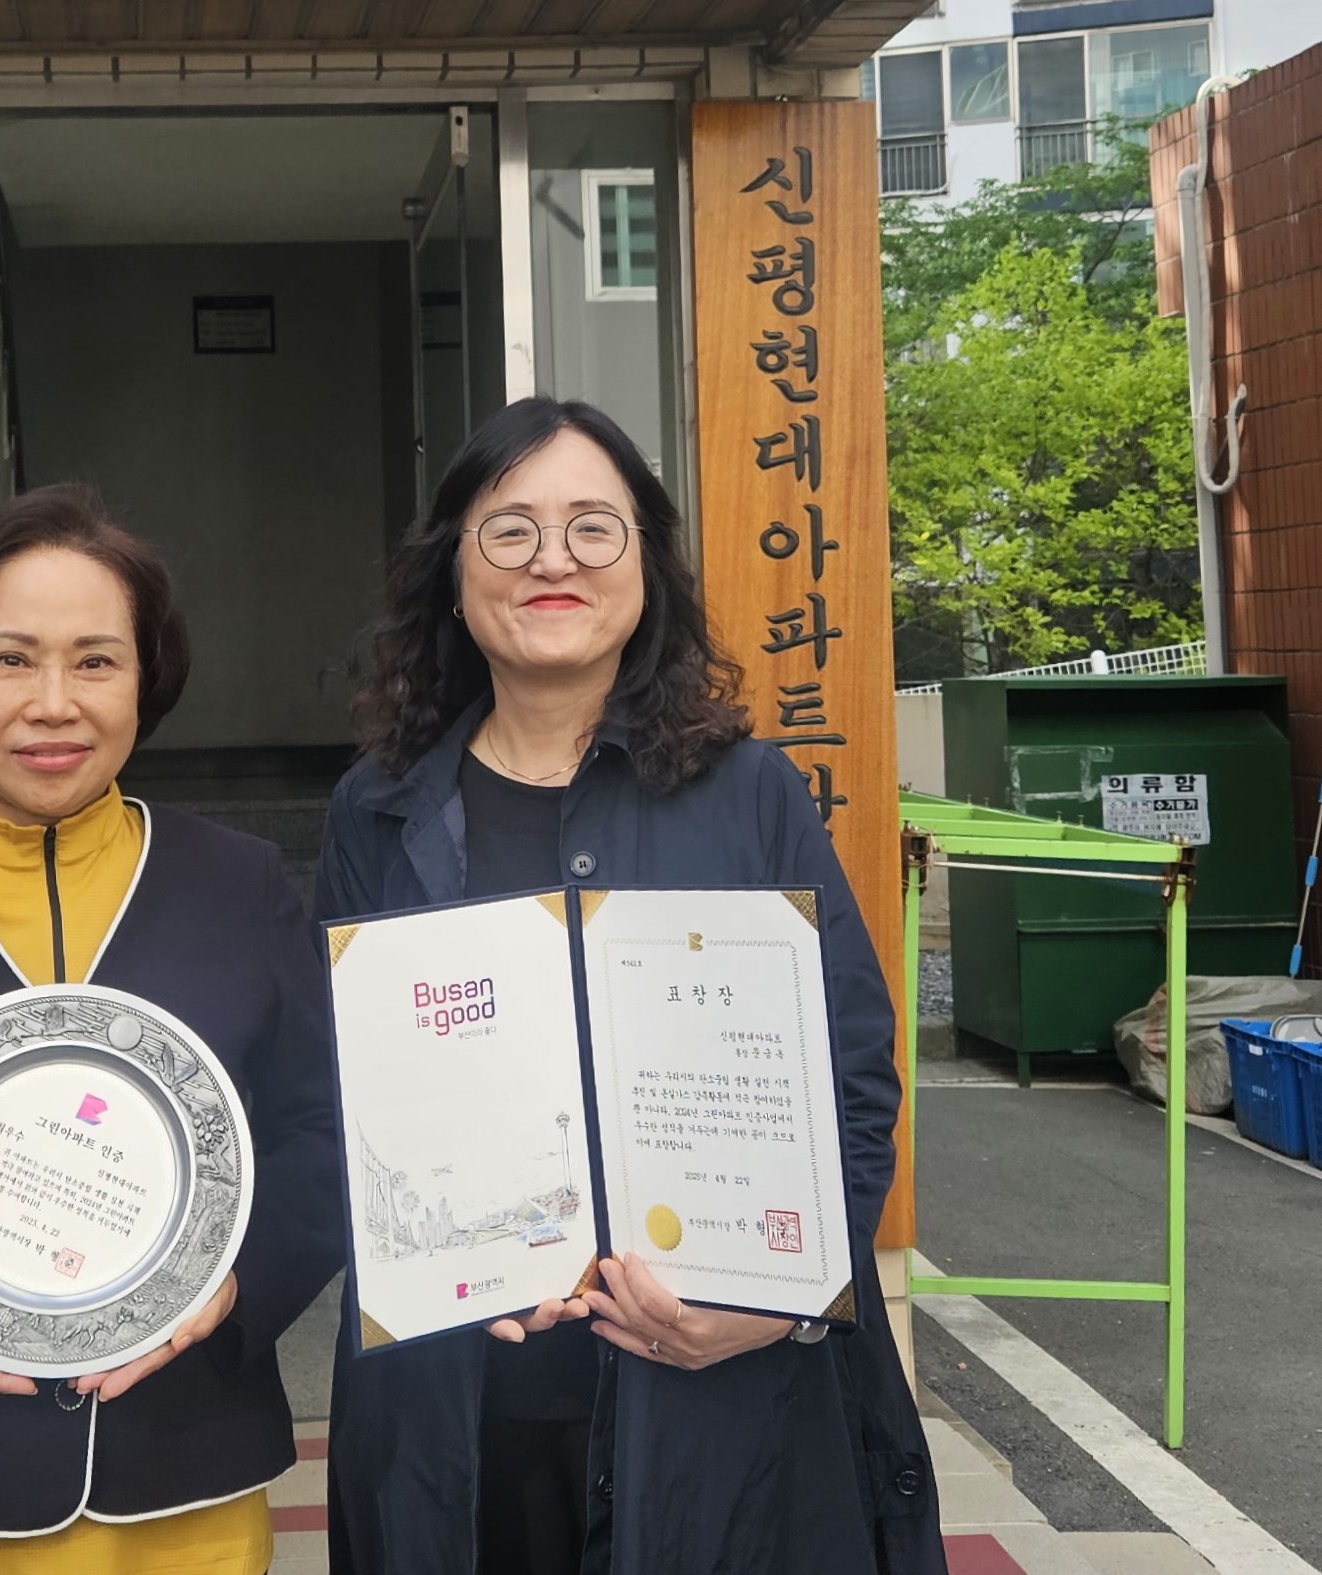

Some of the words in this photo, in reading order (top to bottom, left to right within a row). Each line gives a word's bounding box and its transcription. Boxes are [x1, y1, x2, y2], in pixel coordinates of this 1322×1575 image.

[414, 978, 493, 1008] Busan
[416, 1013, 430, 1028] is
[435, 996, 495, 1036] good
[721, 1031, 782, 1044] 신평현대아파트
[703, 1109, 742, 1121] 그린아파트
[35, 1117, 96, 1150] 그린아파트
[102, 1145, 123, 1163] 인증
